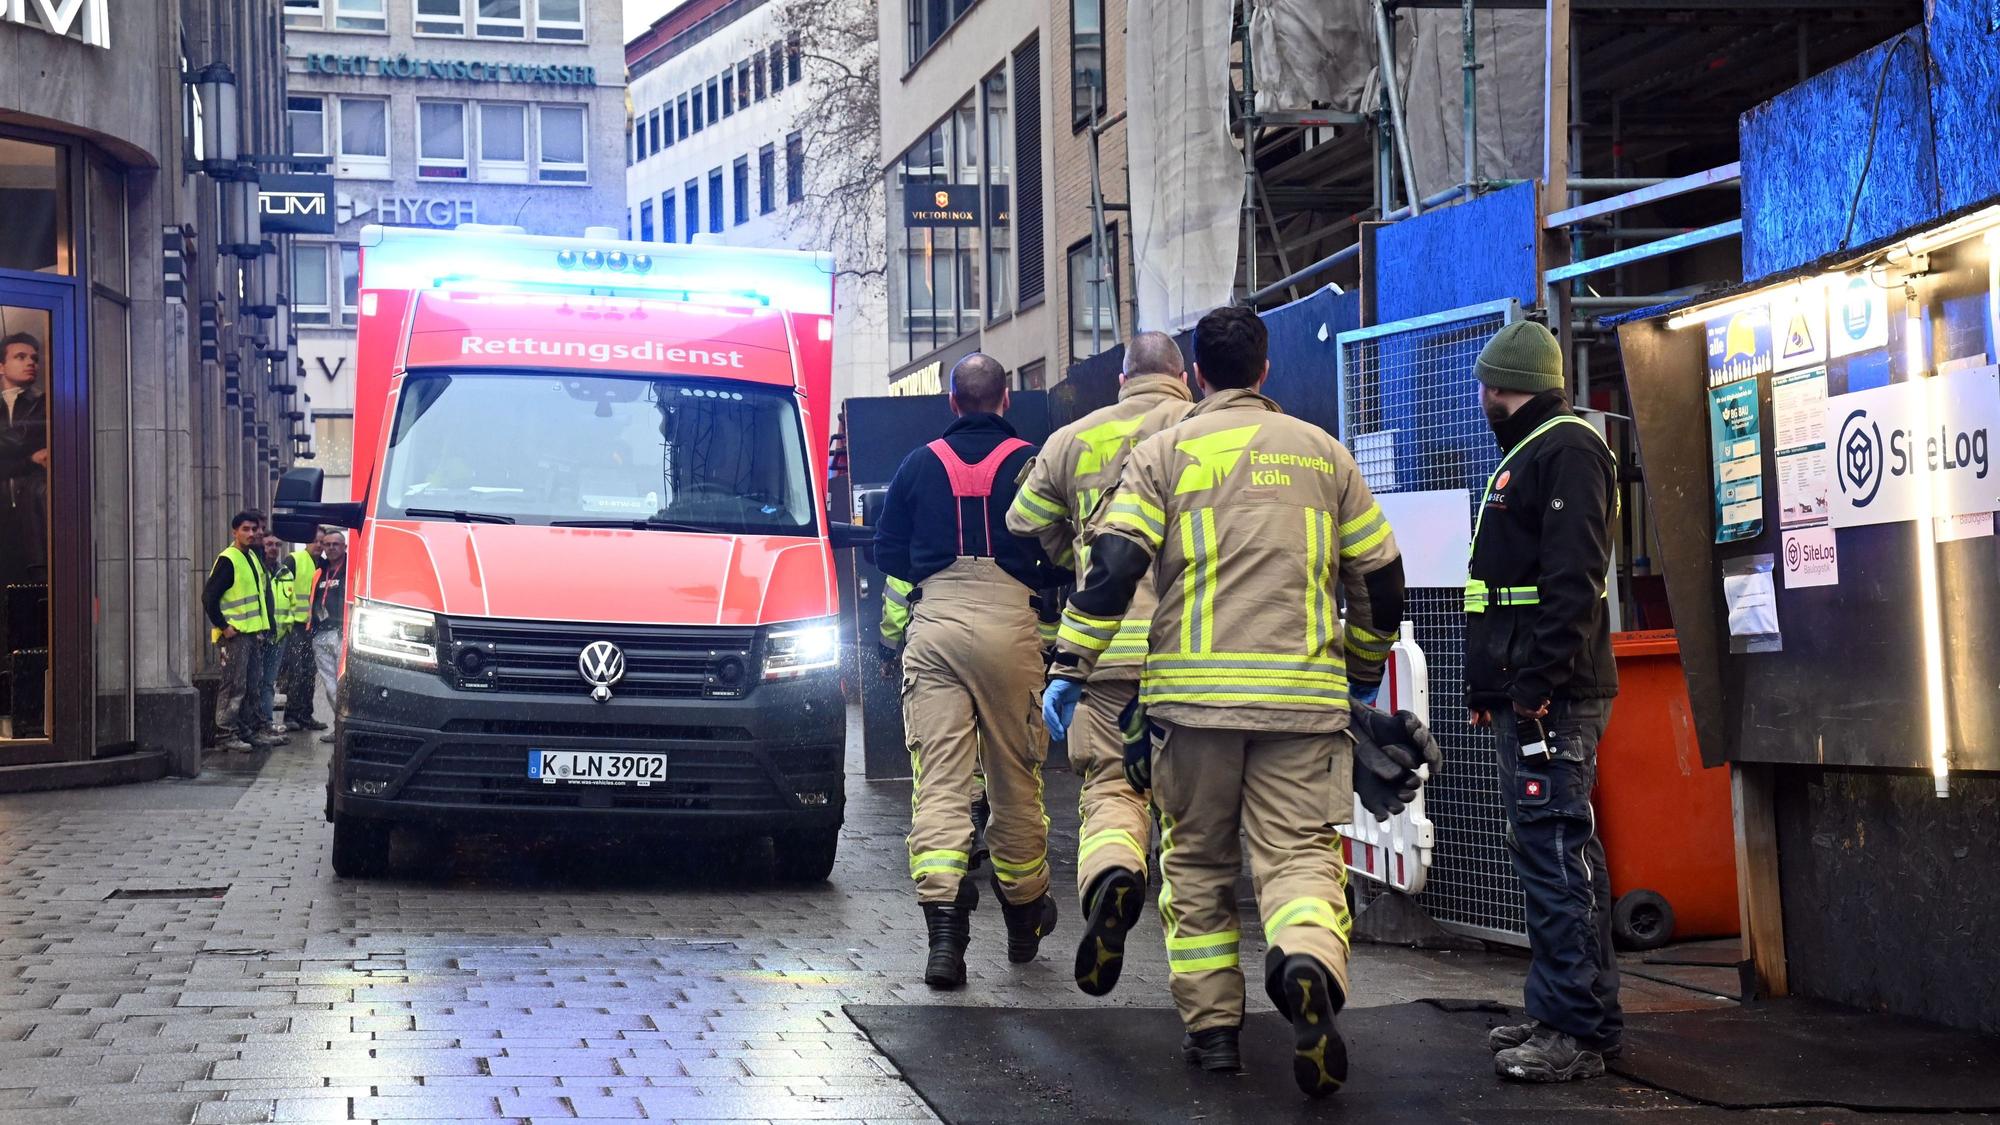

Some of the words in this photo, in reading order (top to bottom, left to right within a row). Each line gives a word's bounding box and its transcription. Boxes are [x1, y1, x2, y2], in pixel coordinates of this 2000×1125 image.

[307, 53, 370, 76] ECHT
[378, 52, 500, 82] KÖLNISCH
[507, 62, 597, 86] WASSER
[378, 197, 477, 226] HYGH
[912, 211, 974, 220] VICTORINOX
[460, 336, 744, 368] Rettungsdienst
[1709, 337, 1724, 357] alle
[1731, 408, 1738, 419] BG
[1738, 405, 1749, 417] BAU
[1890, 424, 1989, 479] SieLog
[1251, 469, 1291, 486] Köln
[1803, 544, 1835, 564] SiteLog
[542, 754, 557, 776] K
[572, 755, 603, 777] LN
[607, 757, 663, 779] 3902
